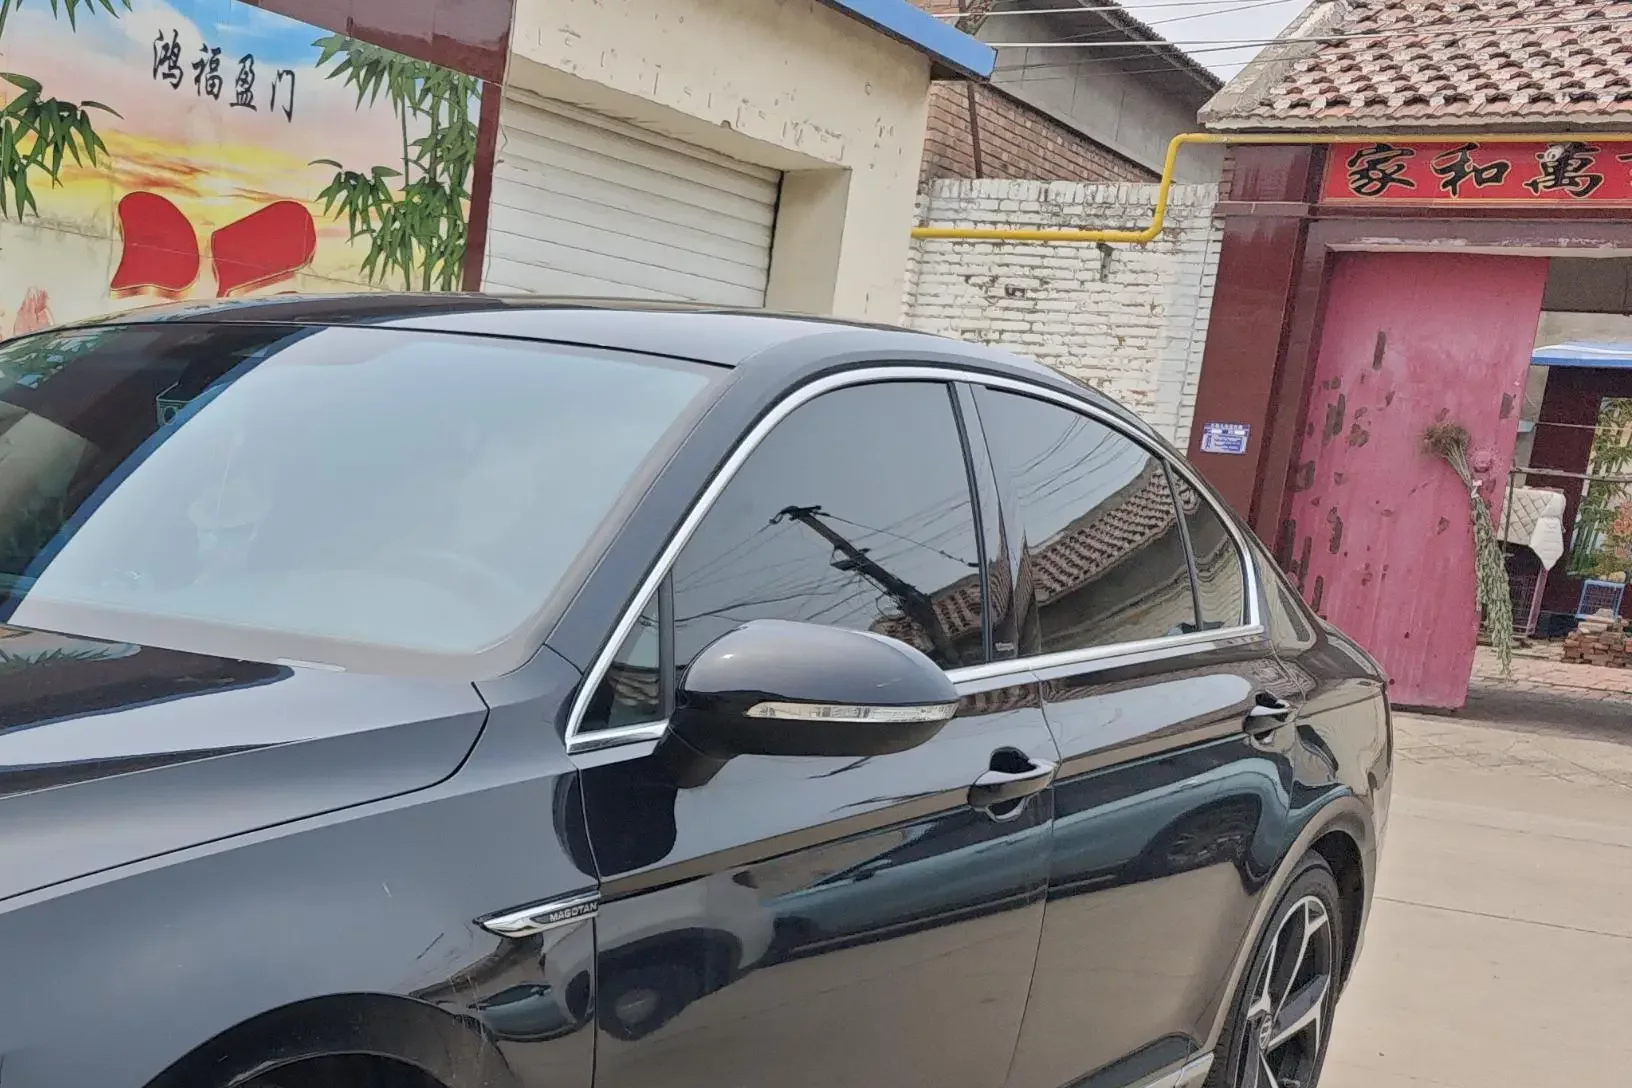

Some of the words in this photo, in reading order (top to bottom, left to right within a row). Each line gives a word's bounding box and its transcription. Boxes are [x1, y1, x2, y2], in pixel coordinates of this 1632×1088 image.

[152, 28, 296, 123] 鸿福盈门
[1347, 142, 1632, 199] 家和萬
[549, 902, 598, 922] MAGOTAN
